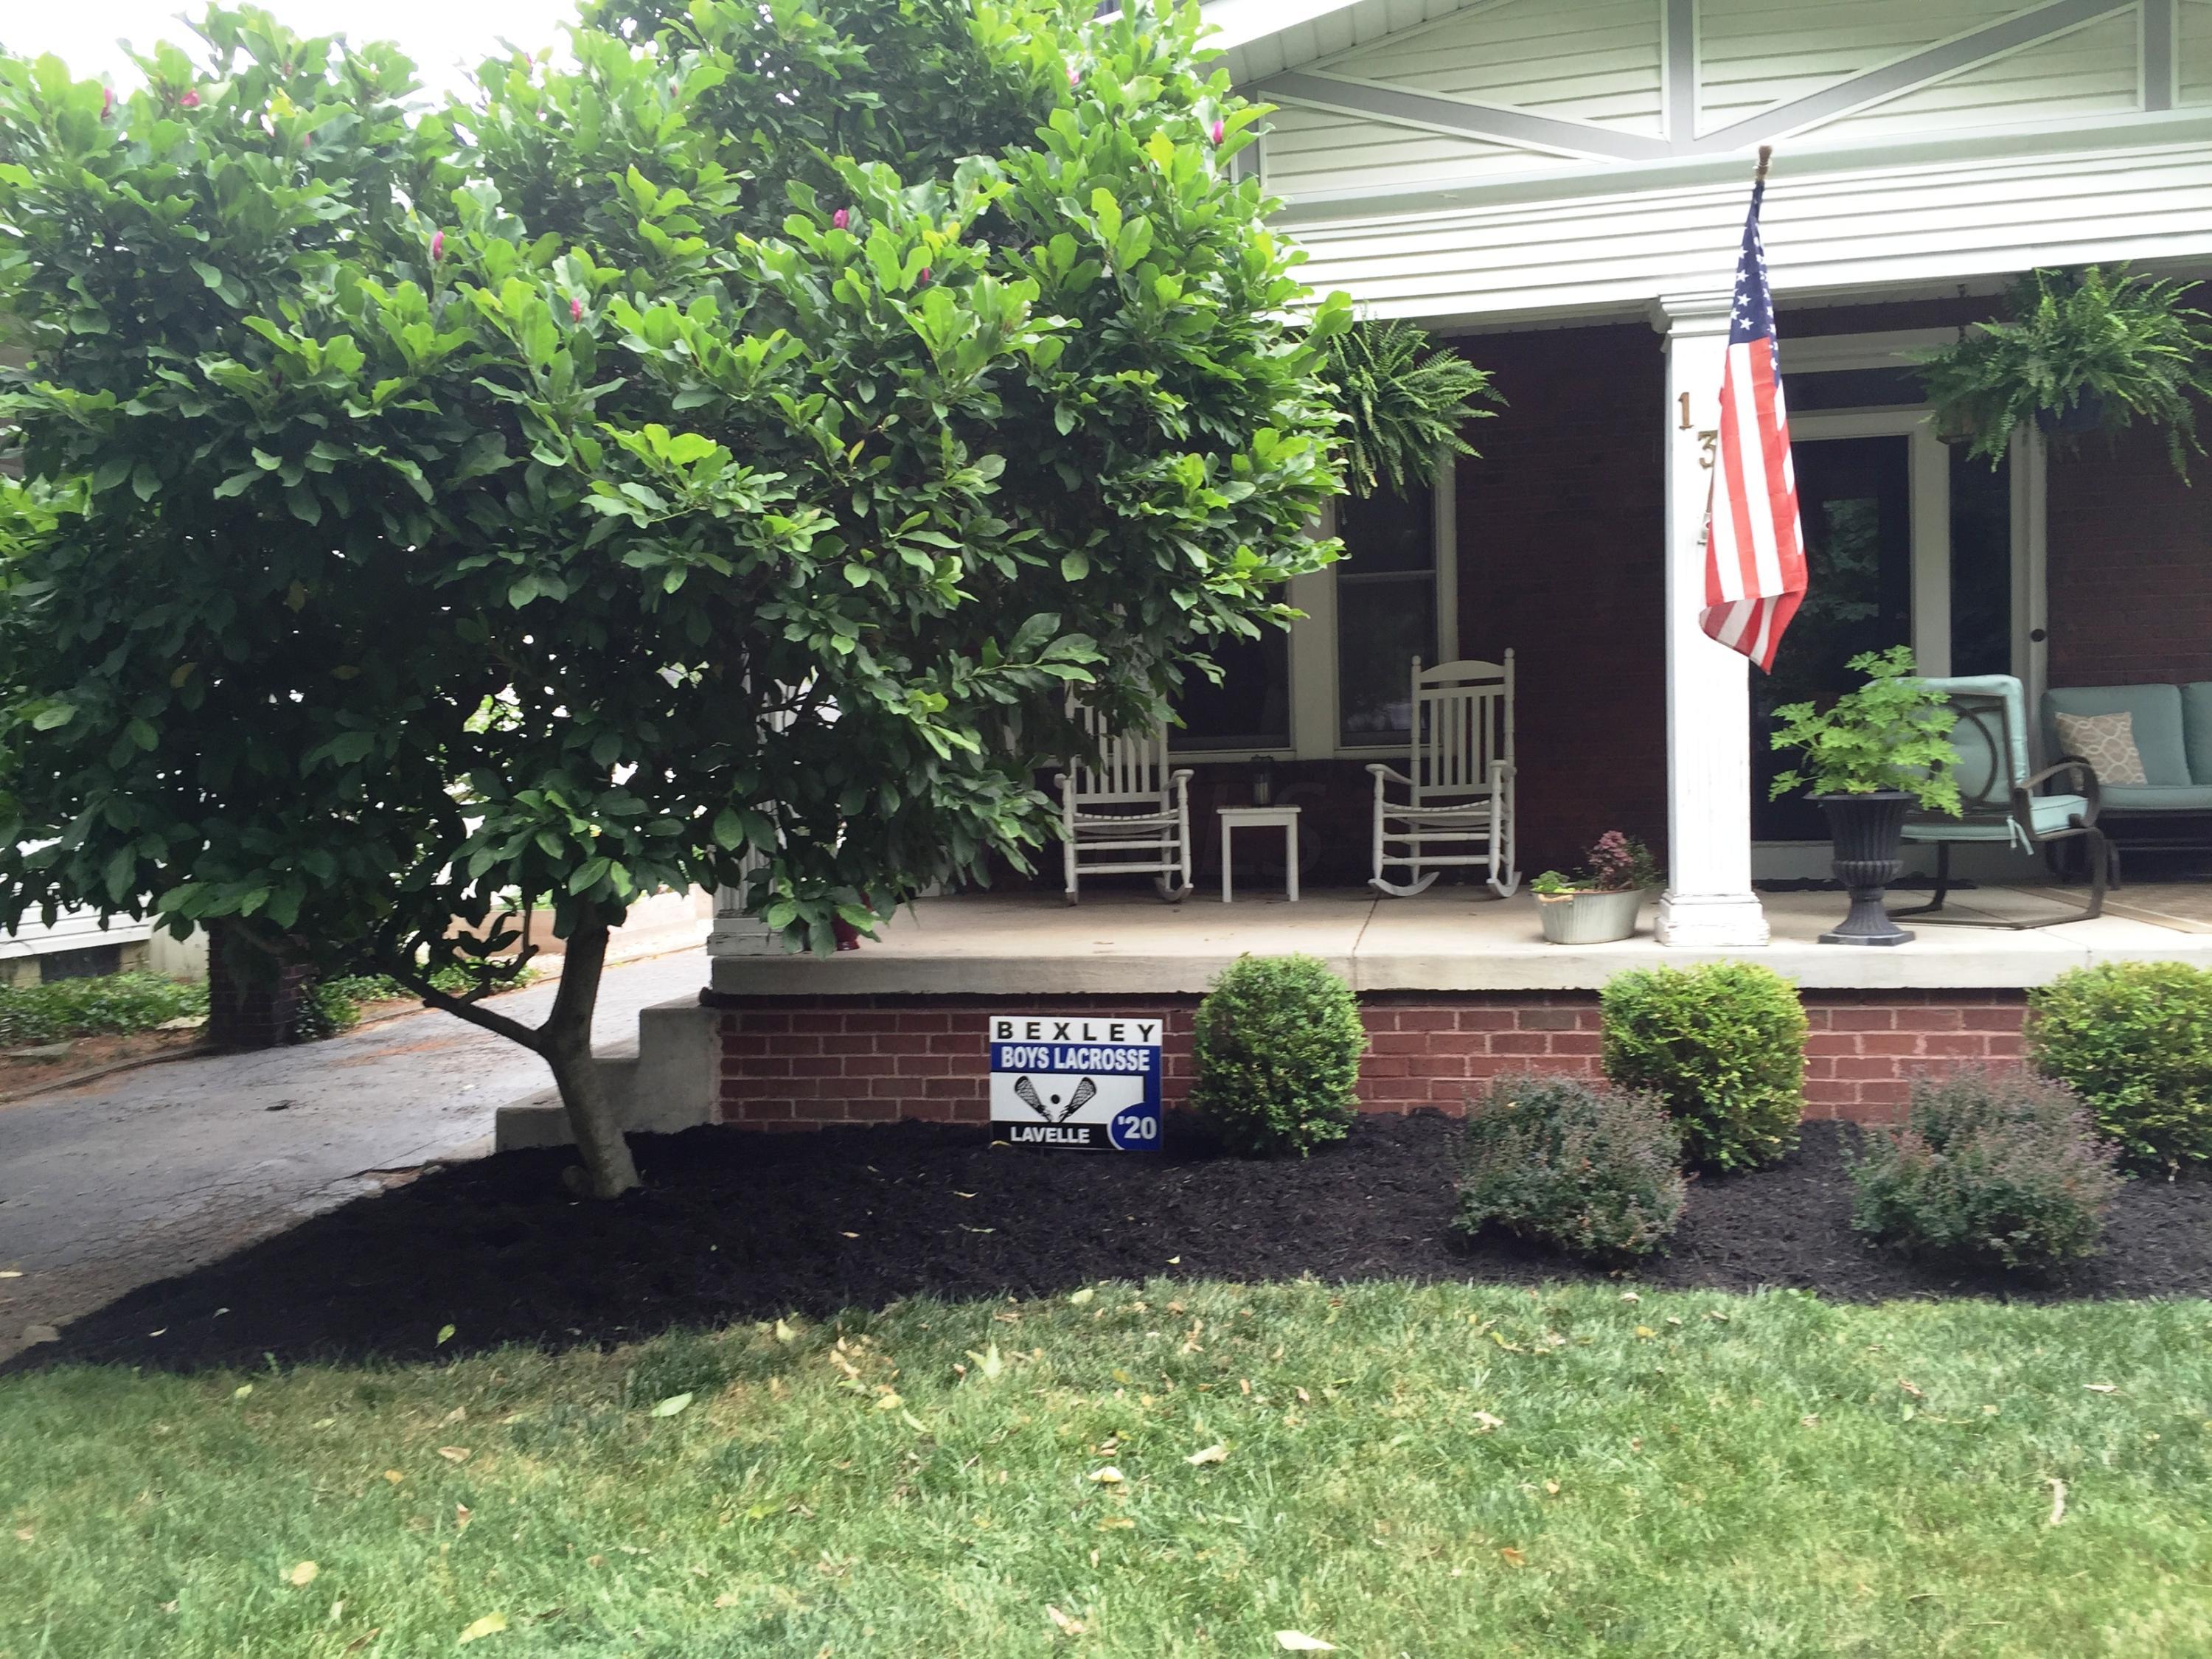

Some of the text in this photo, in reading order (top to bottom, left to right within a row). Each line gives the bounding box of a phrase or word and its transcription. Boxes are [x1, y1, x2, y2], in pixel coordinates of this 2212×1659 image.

[997, 1021, 1155, 1042] BEXLEY
[1001, 1046, 1150, 1071] BOYS LACROSSE
[1010, 1127, 1091, 1144] LAVELLE
